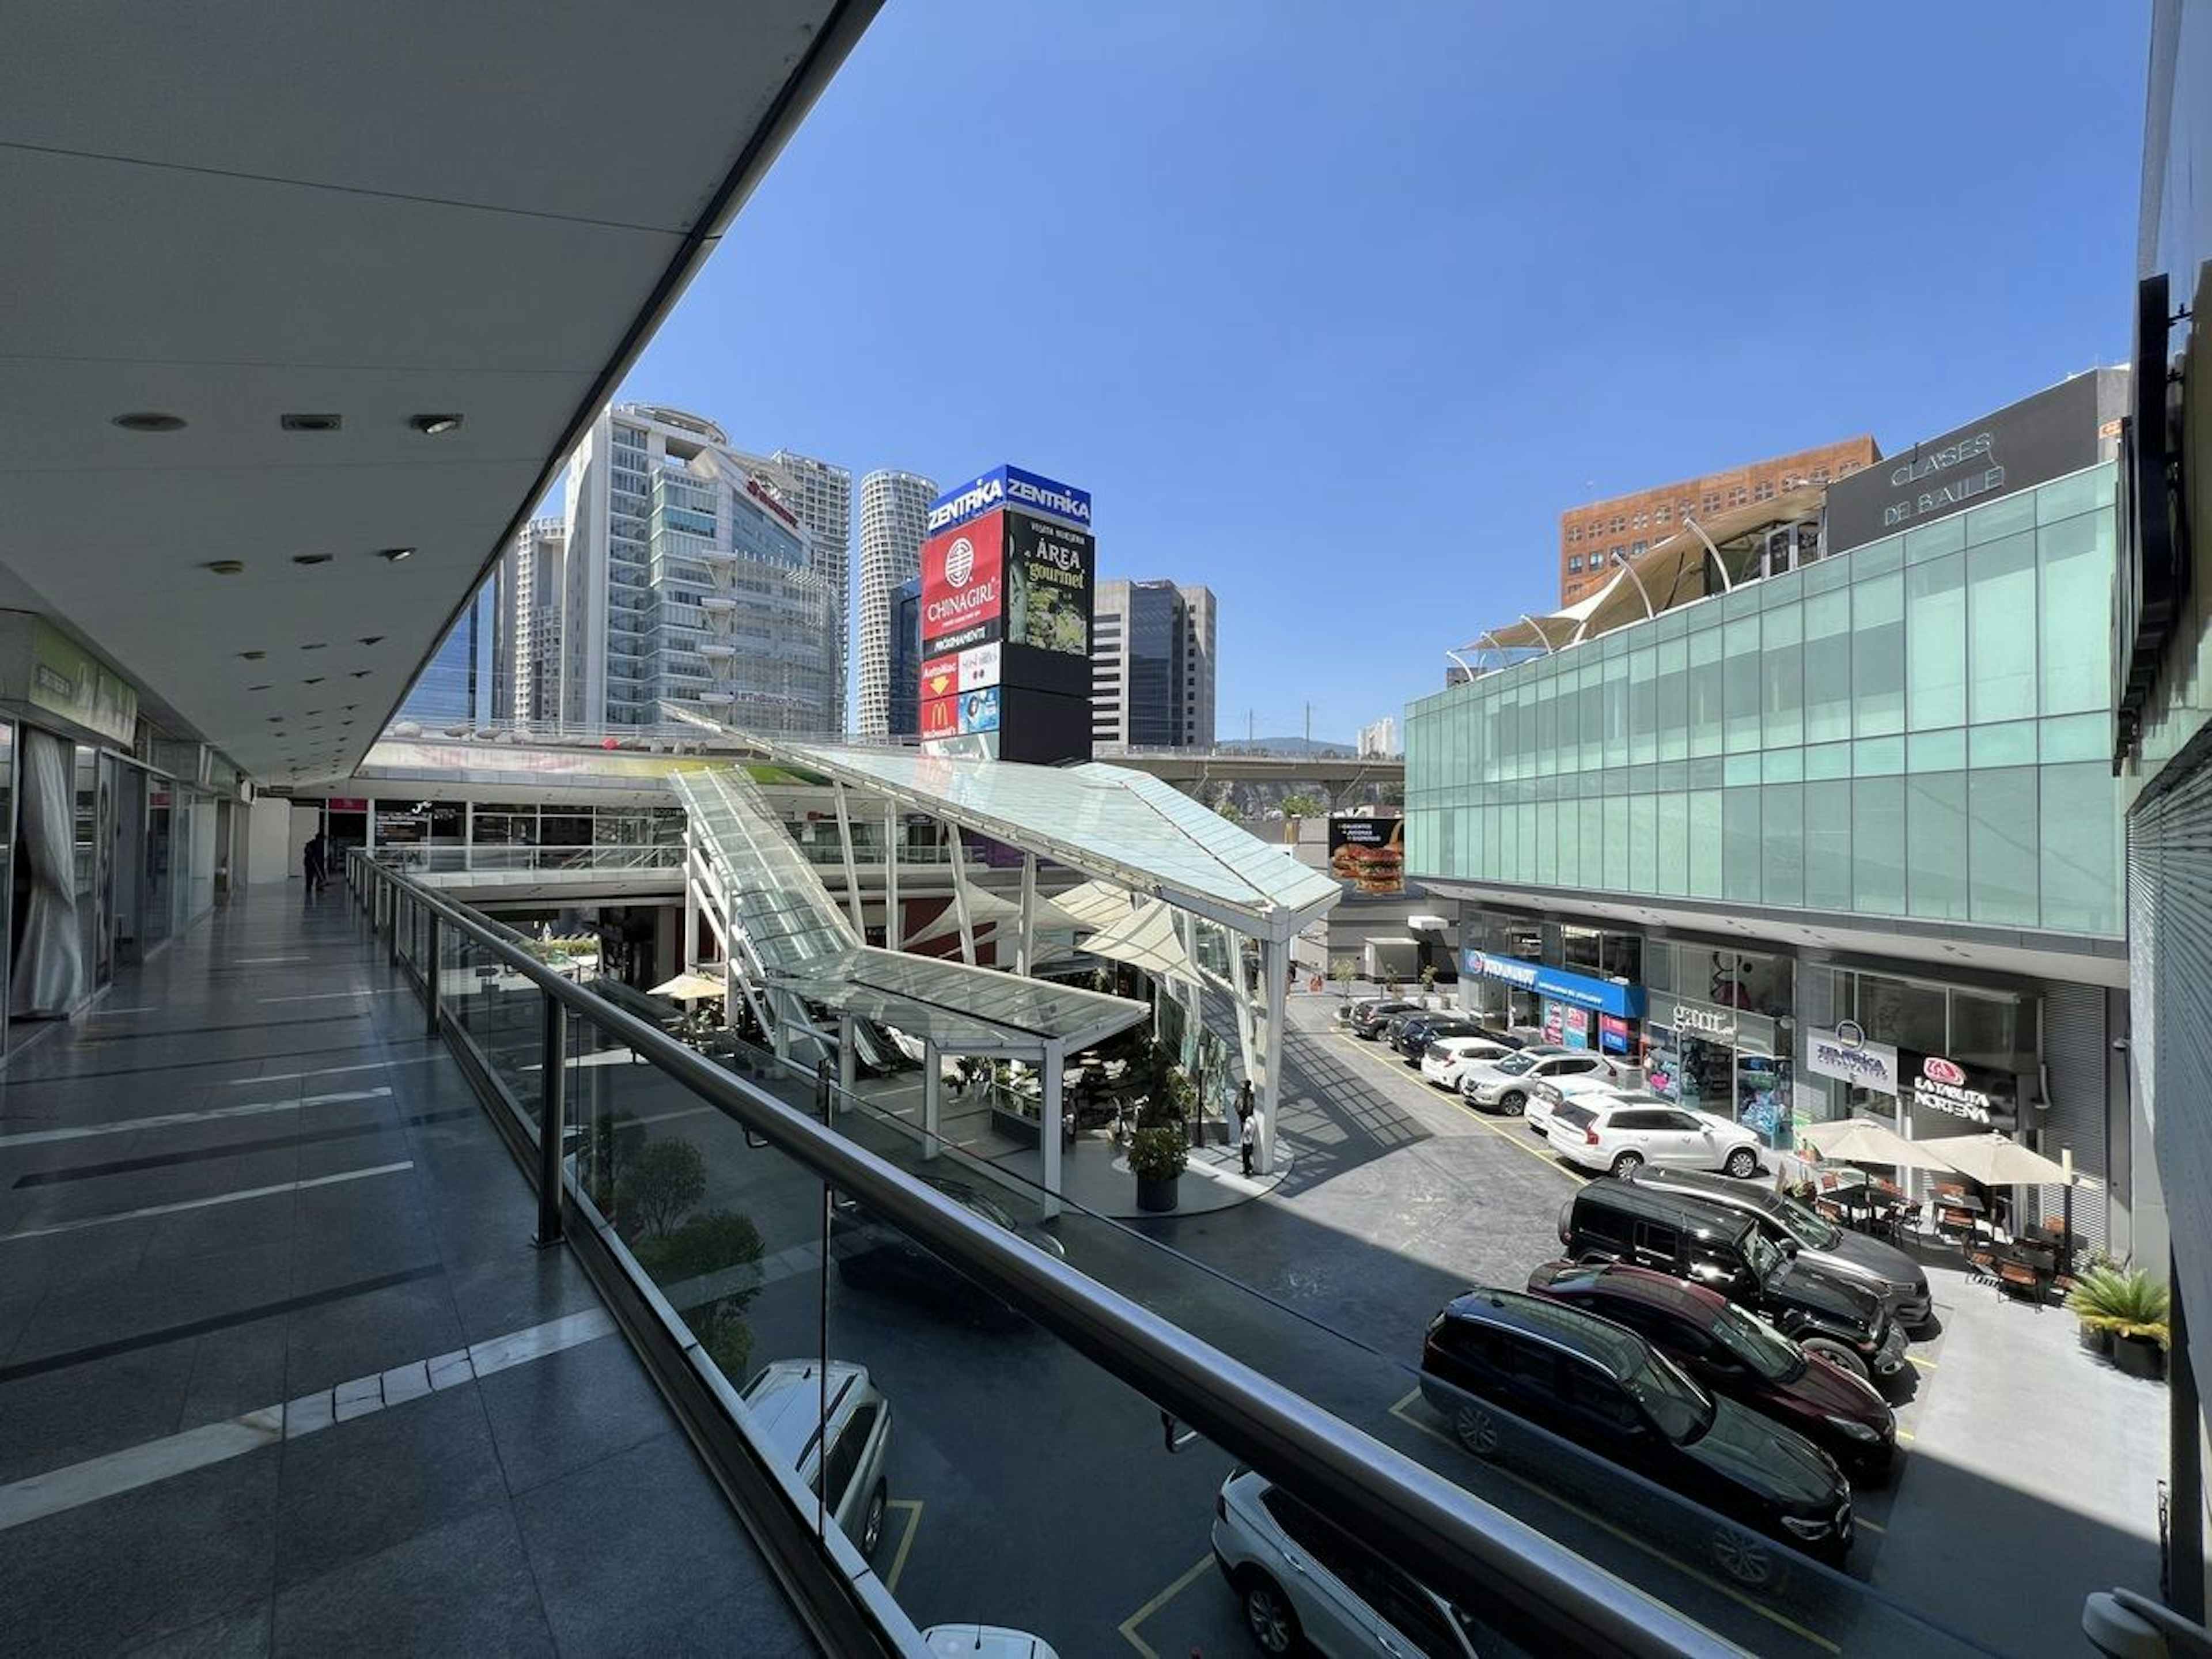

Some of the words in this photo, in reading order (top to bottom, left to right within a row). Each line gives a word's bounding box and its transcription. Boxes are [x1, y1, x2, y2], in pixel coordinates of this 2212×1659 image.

[1891, 433, 1991, 486] CLASES
[1885, 501, 1911, 527] DE
[1918, 466, 2005, 514] BAILE
[1029, 562, 1085, 589] gourmet
[1914, 1075, 1936, 1092] LA
